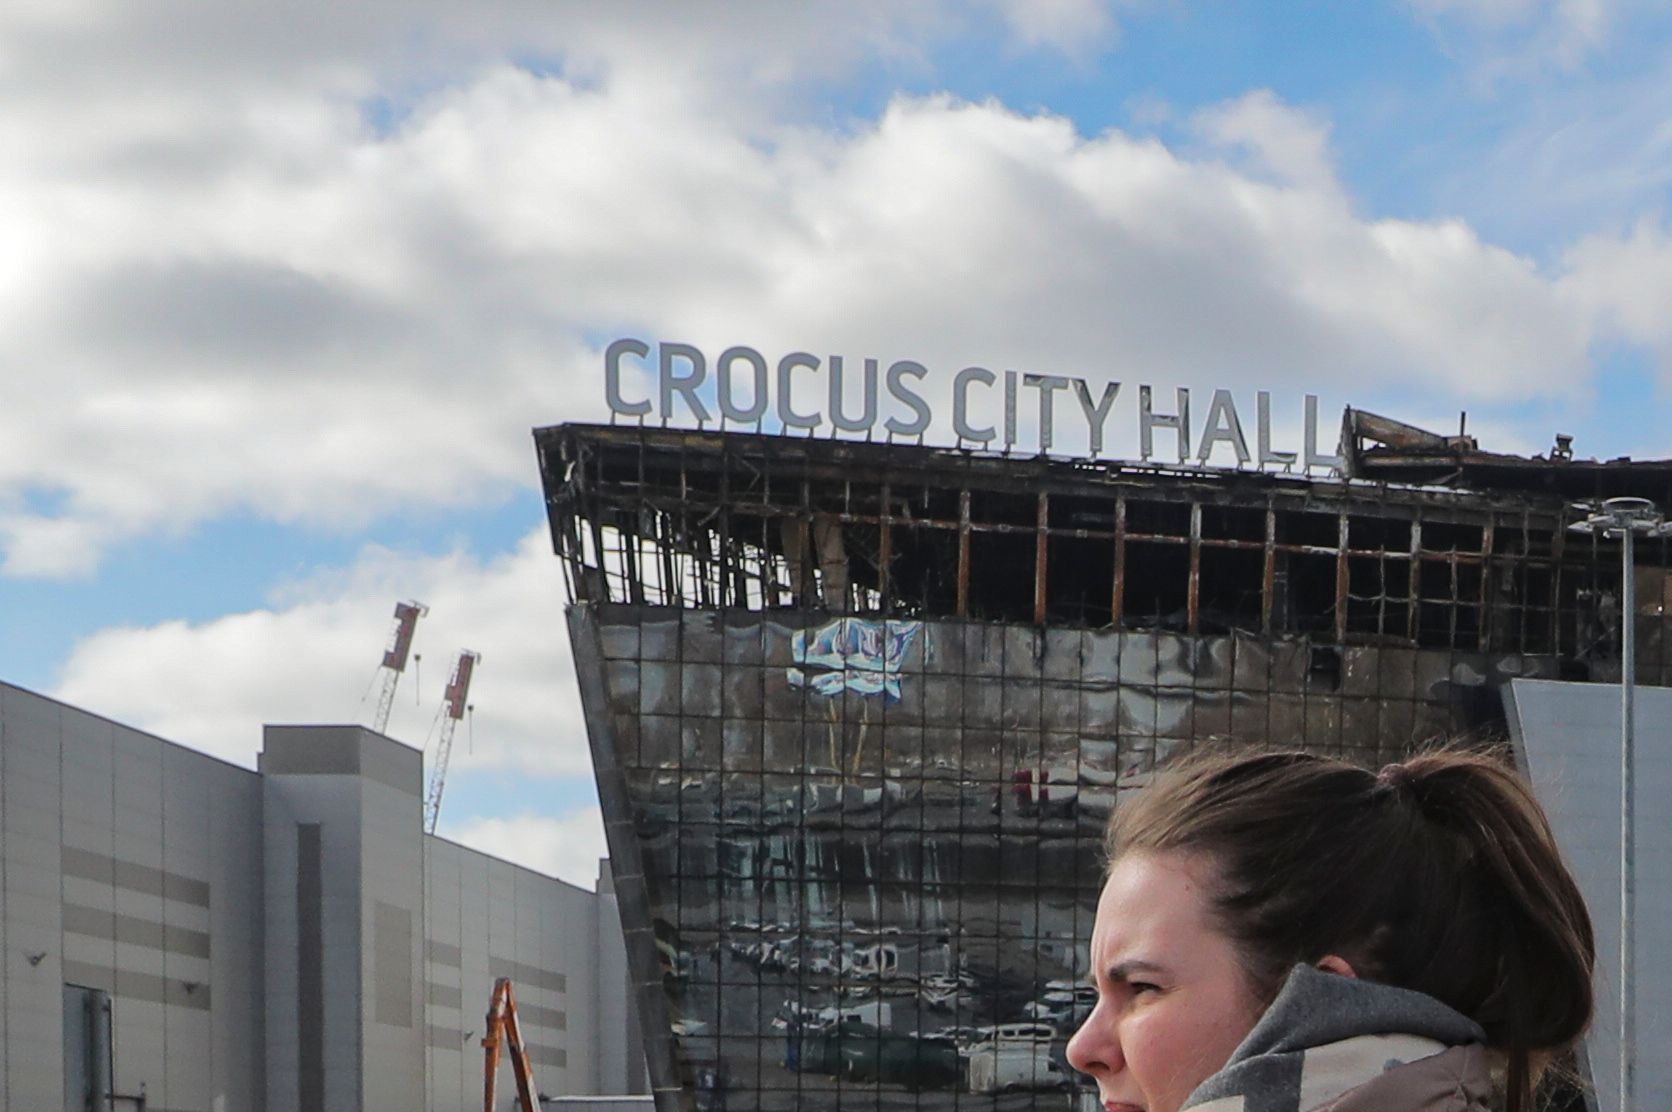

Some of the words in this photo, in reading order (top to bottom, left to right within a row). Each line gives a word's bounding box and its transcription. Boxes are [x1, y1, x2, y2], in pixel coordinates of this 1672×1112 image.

[604, 337, 933, 437] CROCUS
[952, 366, 1122, 454] CITY
[1138, 383, 1343, 468] HALL
